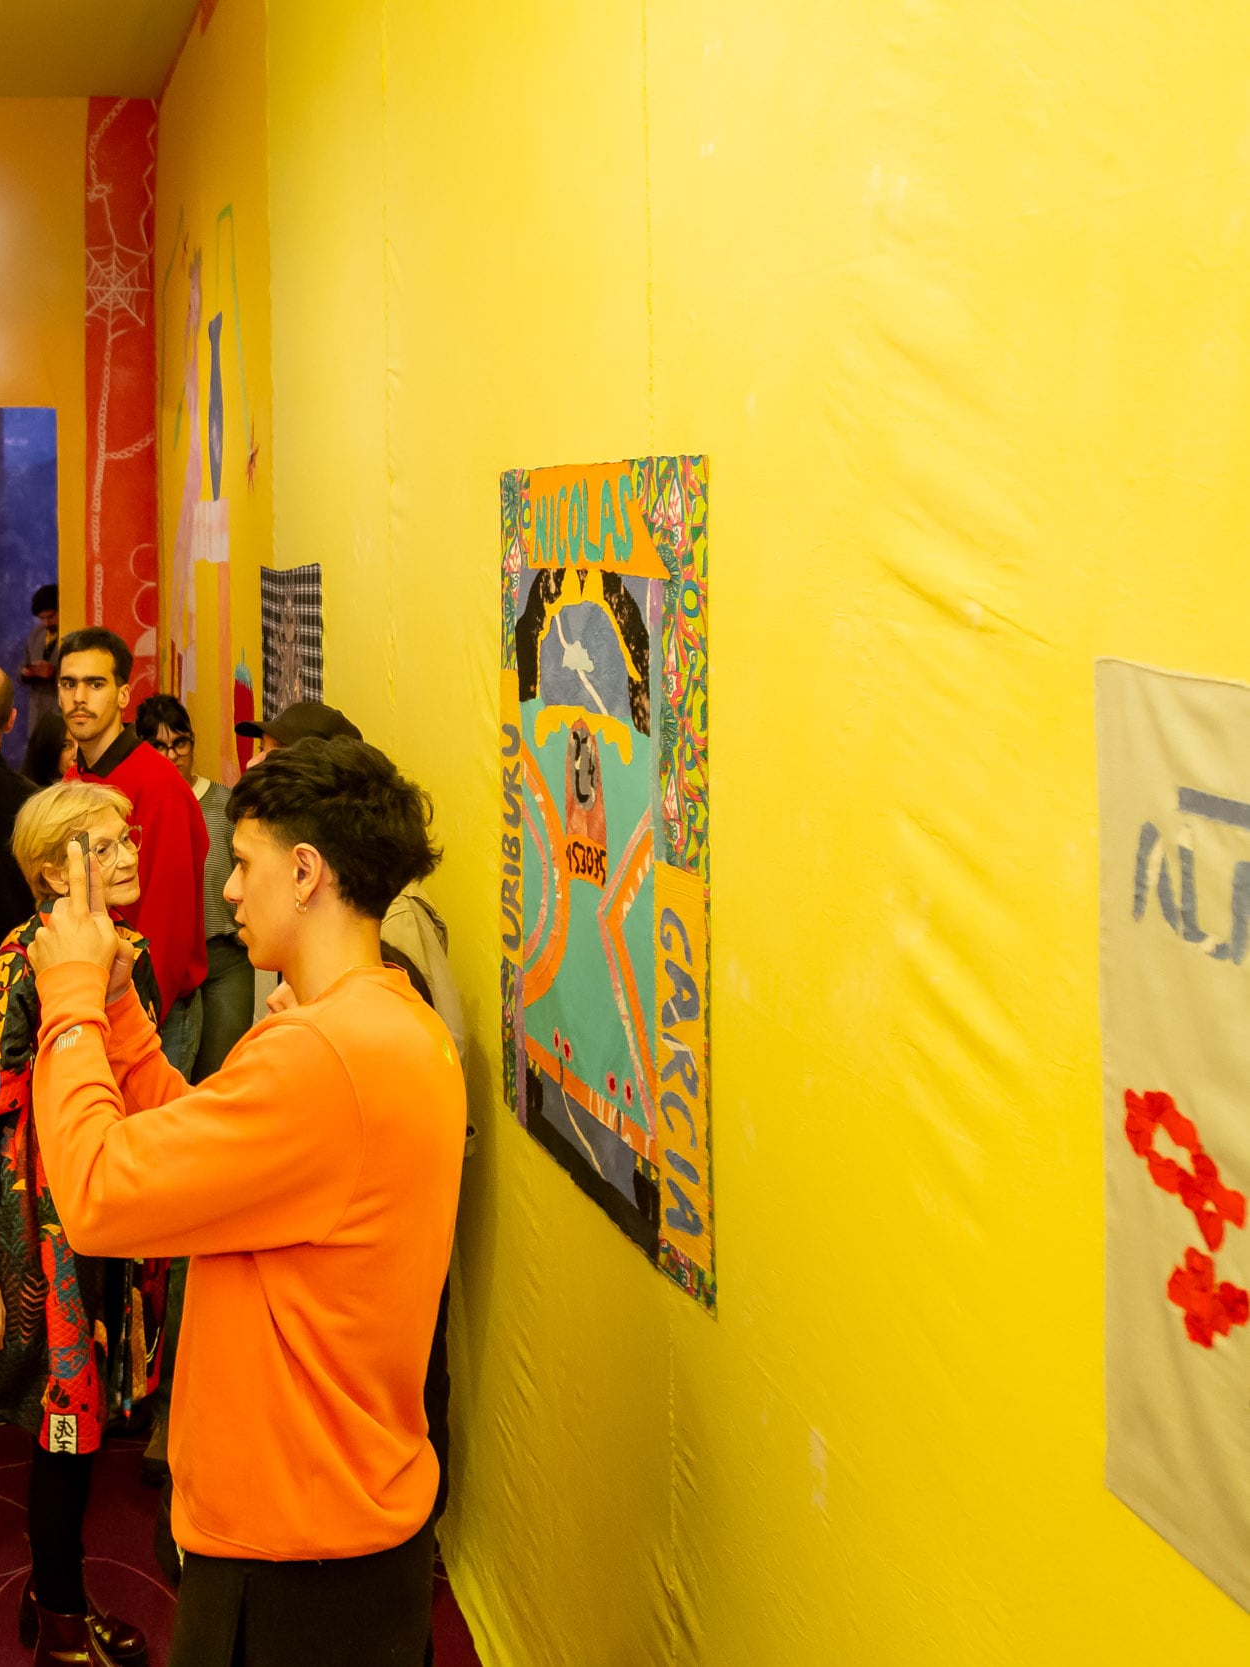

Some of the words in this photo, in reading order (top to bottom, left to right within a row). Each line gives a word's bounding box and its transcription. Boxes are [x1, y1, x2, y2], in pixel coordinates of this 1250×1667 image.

[532, 474, 634, 567] NICOLAS
[501, 722, 523, 952] URIBURU
[660, 907, 704, 1236] GARCIA
